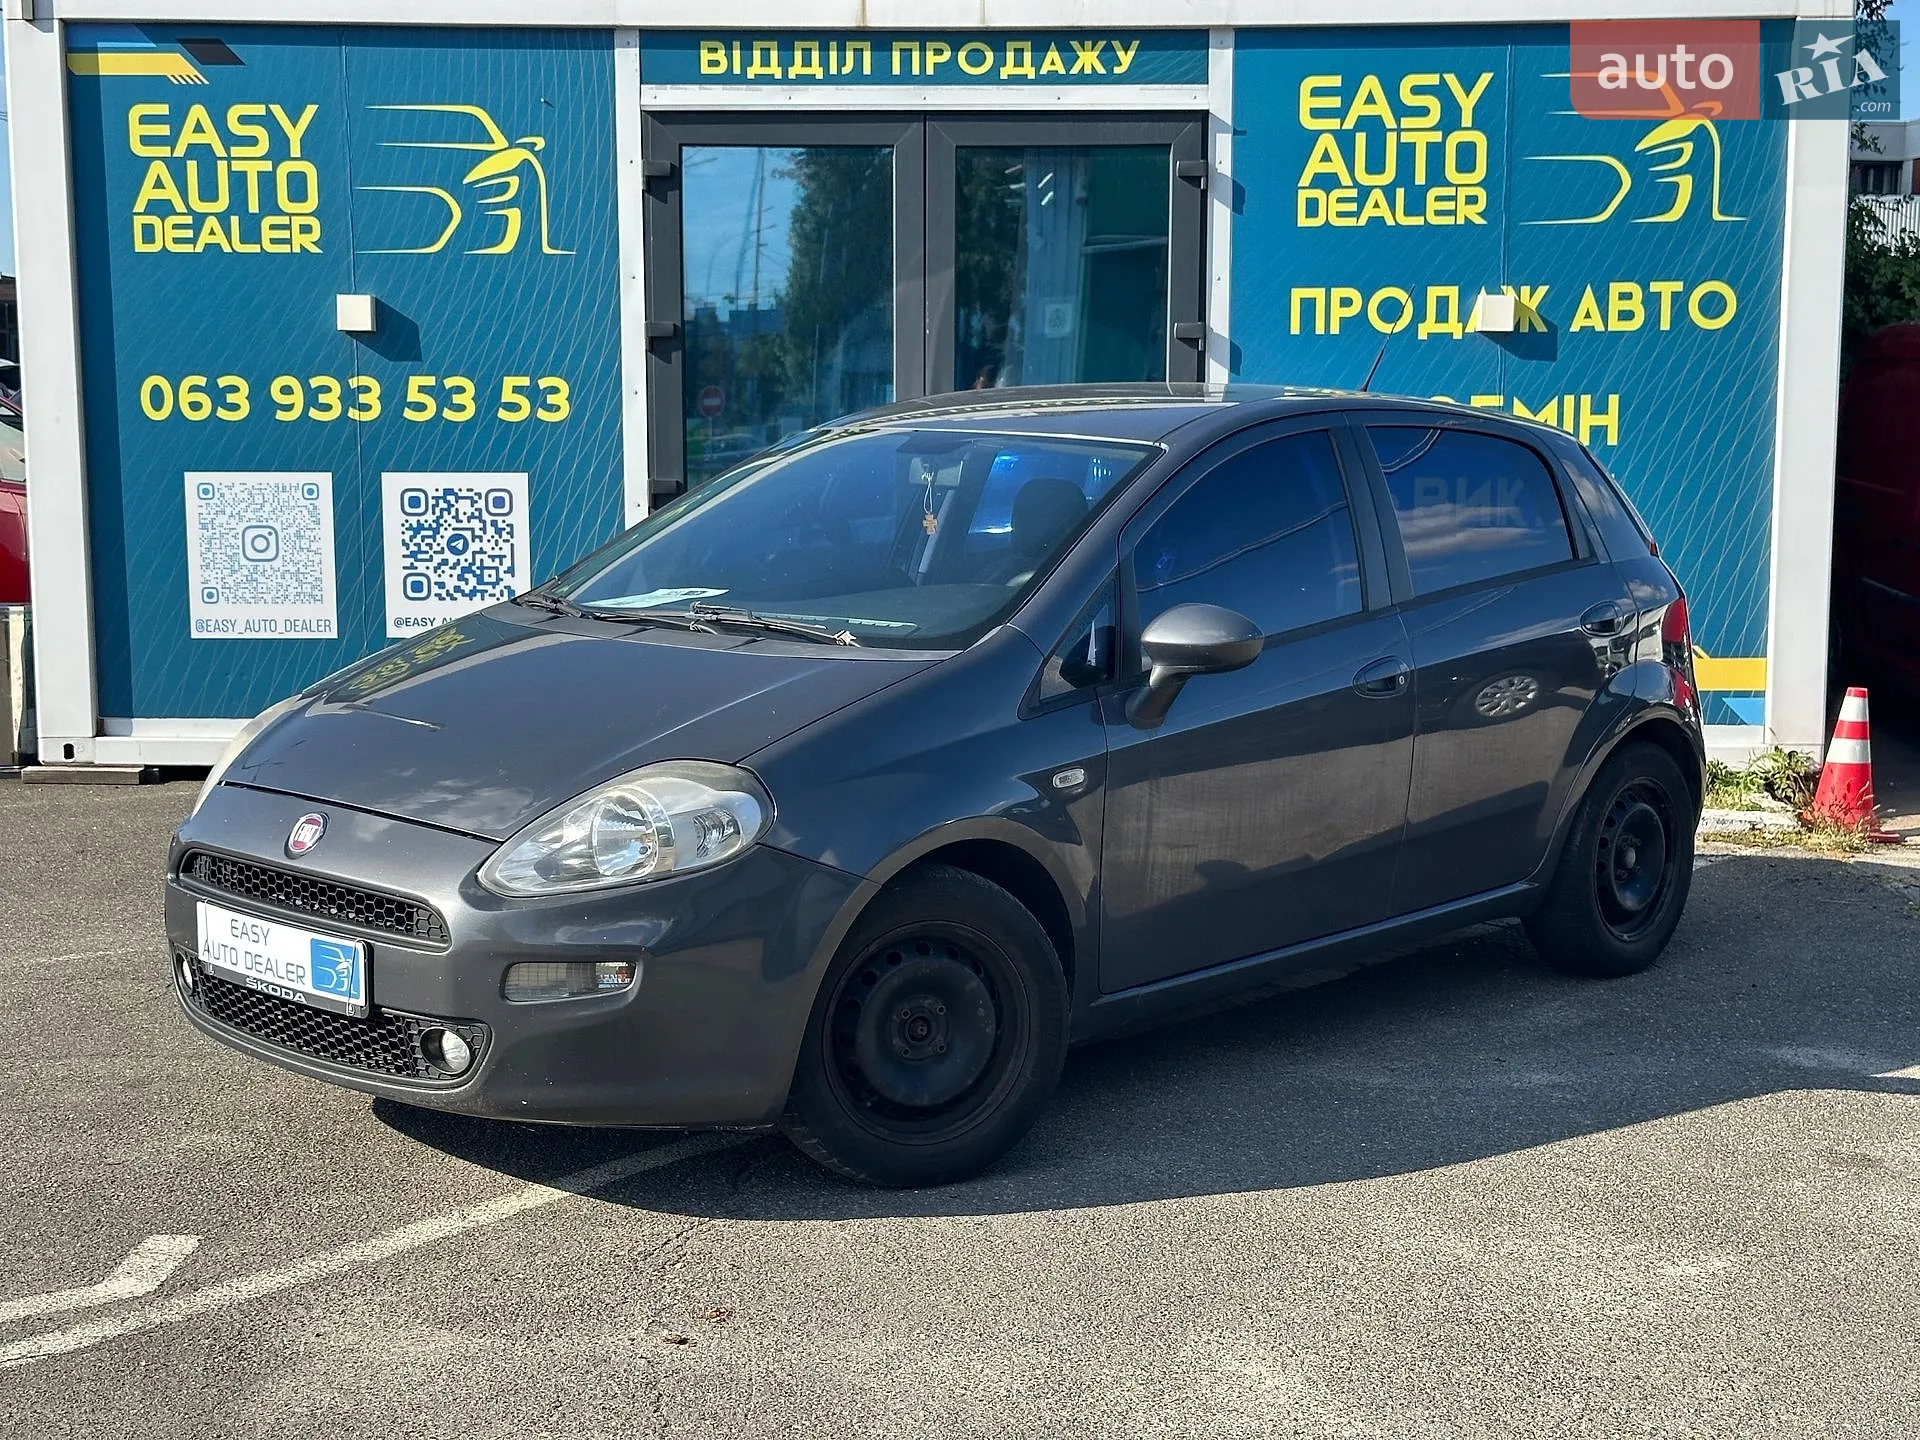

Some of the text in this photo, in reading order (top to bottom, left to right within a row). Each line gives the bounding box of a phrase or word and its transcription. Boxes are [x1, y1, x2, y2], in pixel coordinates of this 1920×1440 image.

[699, 40, 1140, 79] ВІДДІЛ ПРОДАЖУ
[1298, 72, 1495, 130] EASY
[128, 104, 319, 158] EASY
[1298, 130, 1488, 188] AUTO
[133, 160, 319, 214] AUTO
[1297, 186, 1488, 227] DEALER
[133, 215, 323, 253] DEALER
[1570, 280, 1737, 333] АВТО
[140, 375, 571, 422] 063 933 53 53
[230, 918, 271, 946] EASY
[202, 938, 306, 986] AUTO DEALER
